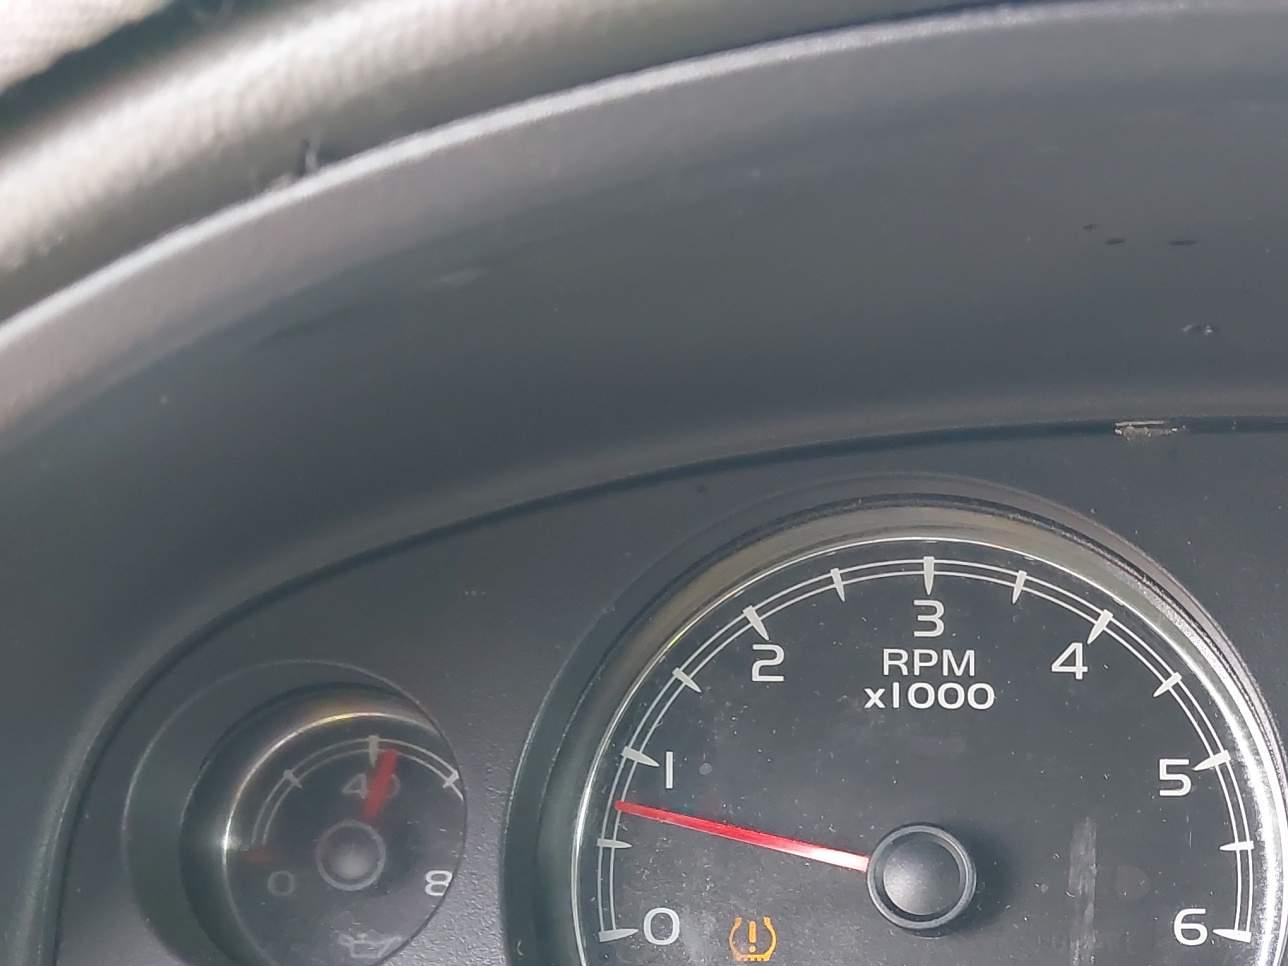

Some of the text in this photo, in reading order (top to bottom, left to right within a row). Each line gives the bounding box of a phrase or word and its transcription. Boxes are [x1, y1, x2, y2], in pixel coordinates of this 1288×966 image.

[914, 600, 944, 638] 3
[751, 645, 785, 682] 2
[882, 648, 976, 677] RPM
[1051, 642, 1088, 680] 4
[864, 682, 994, 710] x1000
[664, 750, 674, 789] 1
[1158, 758, 1191, 796] 5
[267, 870, 296, 897] 0
[643, 907, 680, 945] 0
[1173, 907, 1208, 945] 6
